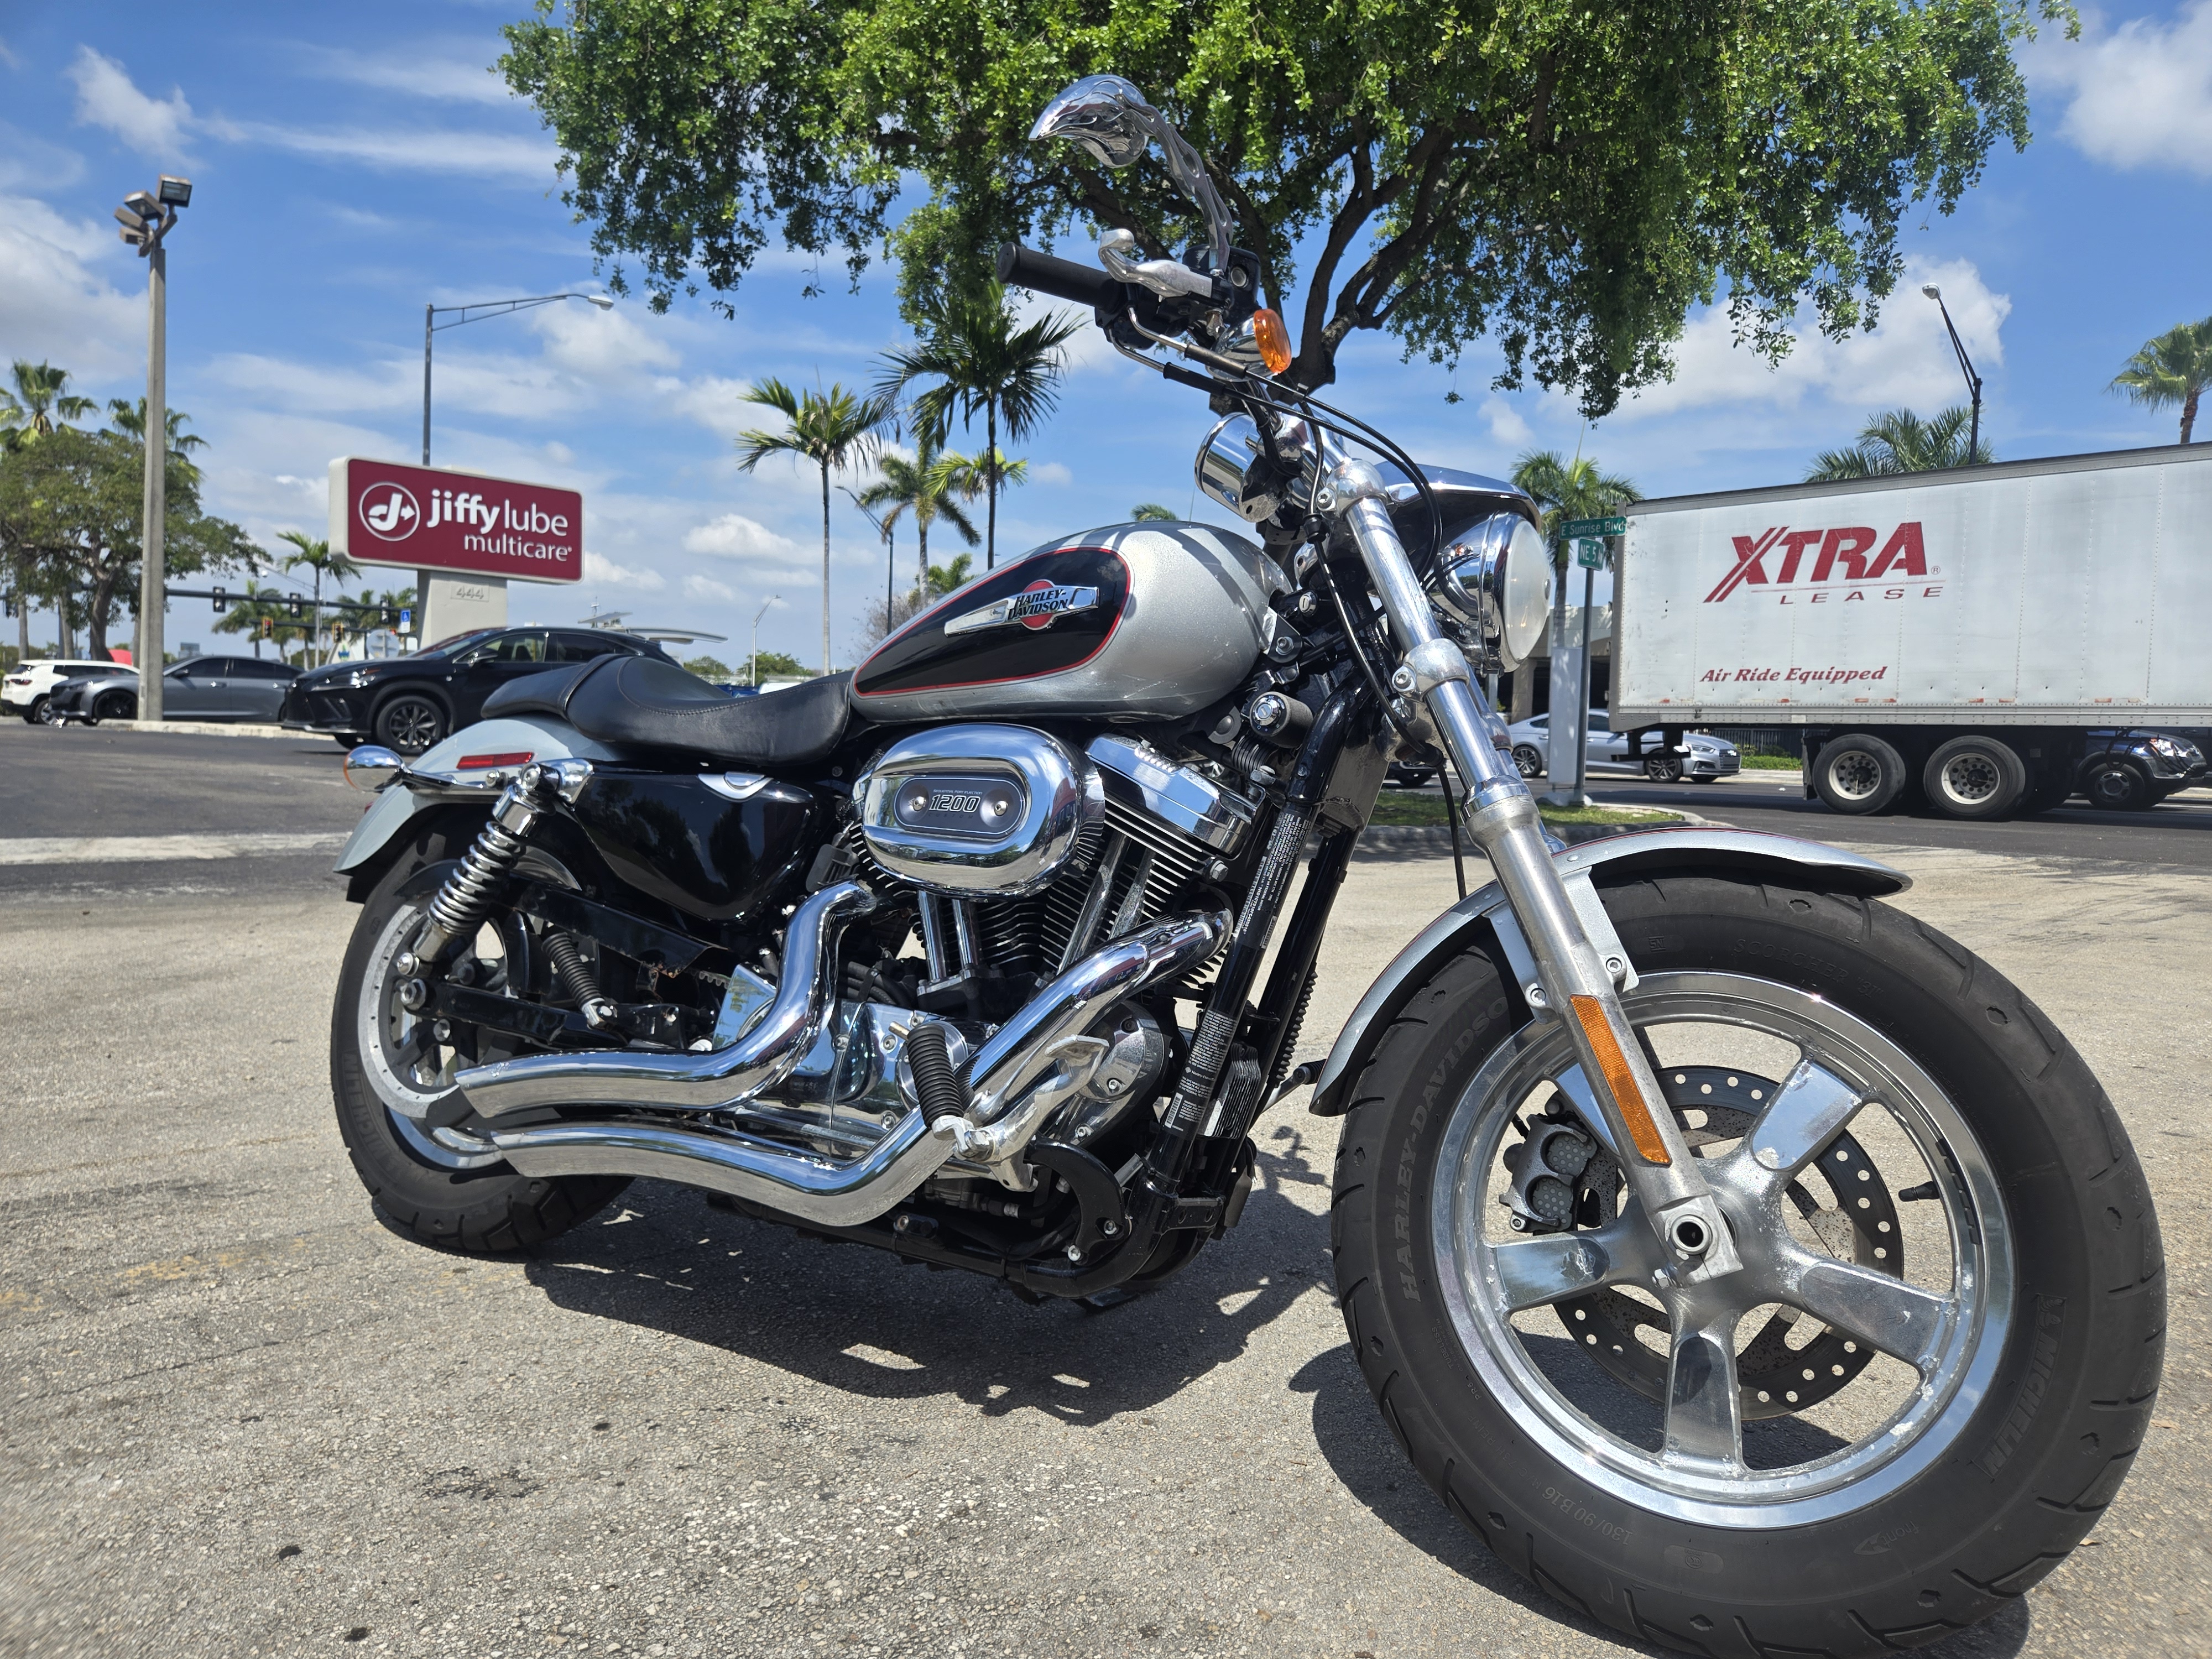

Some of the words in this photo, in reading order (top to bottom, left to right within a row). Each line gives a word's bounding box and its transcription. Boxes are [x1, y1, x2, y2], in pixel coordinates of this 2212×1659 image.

[427, 489, 500, 534] jiffy
[505, 499, 568, 536] lube
[1561, 525, 1566, 536] E
[1569, 524, 1600, 535] Sunrise
[1605, 521, 1624, 532] Blvd
[464, 533, 568, 562] multicare
[1580, 544, 1590, 561] NE
[1593, 547, 1596, 562] 5
[1703, 521, 1927, 603] XTRA
[456, 585, 484, 599] 444
[1016, 588, 1066, 608] HARLEY-
[1780, 587, 1943, 604] LEASE
[1008, 599, 1069, 620] DAVIDSON
[1700, 668, 1731, 682] Air
[1735, 668, 1780, 682] Ride
[1785, 666, 1888, 684] Equipped
[929, 794, 981, 813] 1200
[1395, 997, 1508, 1302] HARLEY-DAVIDSO
[1431, 1326, 1455, 1370] TUBELESS
[1982, 1332, 2058, 1475] MICHELIN
[1541, 1484, 1577, 1515] B16
[1573, 1505, 1634, 1546] 130/90
[1880, 1520, 1921, 1549] front
